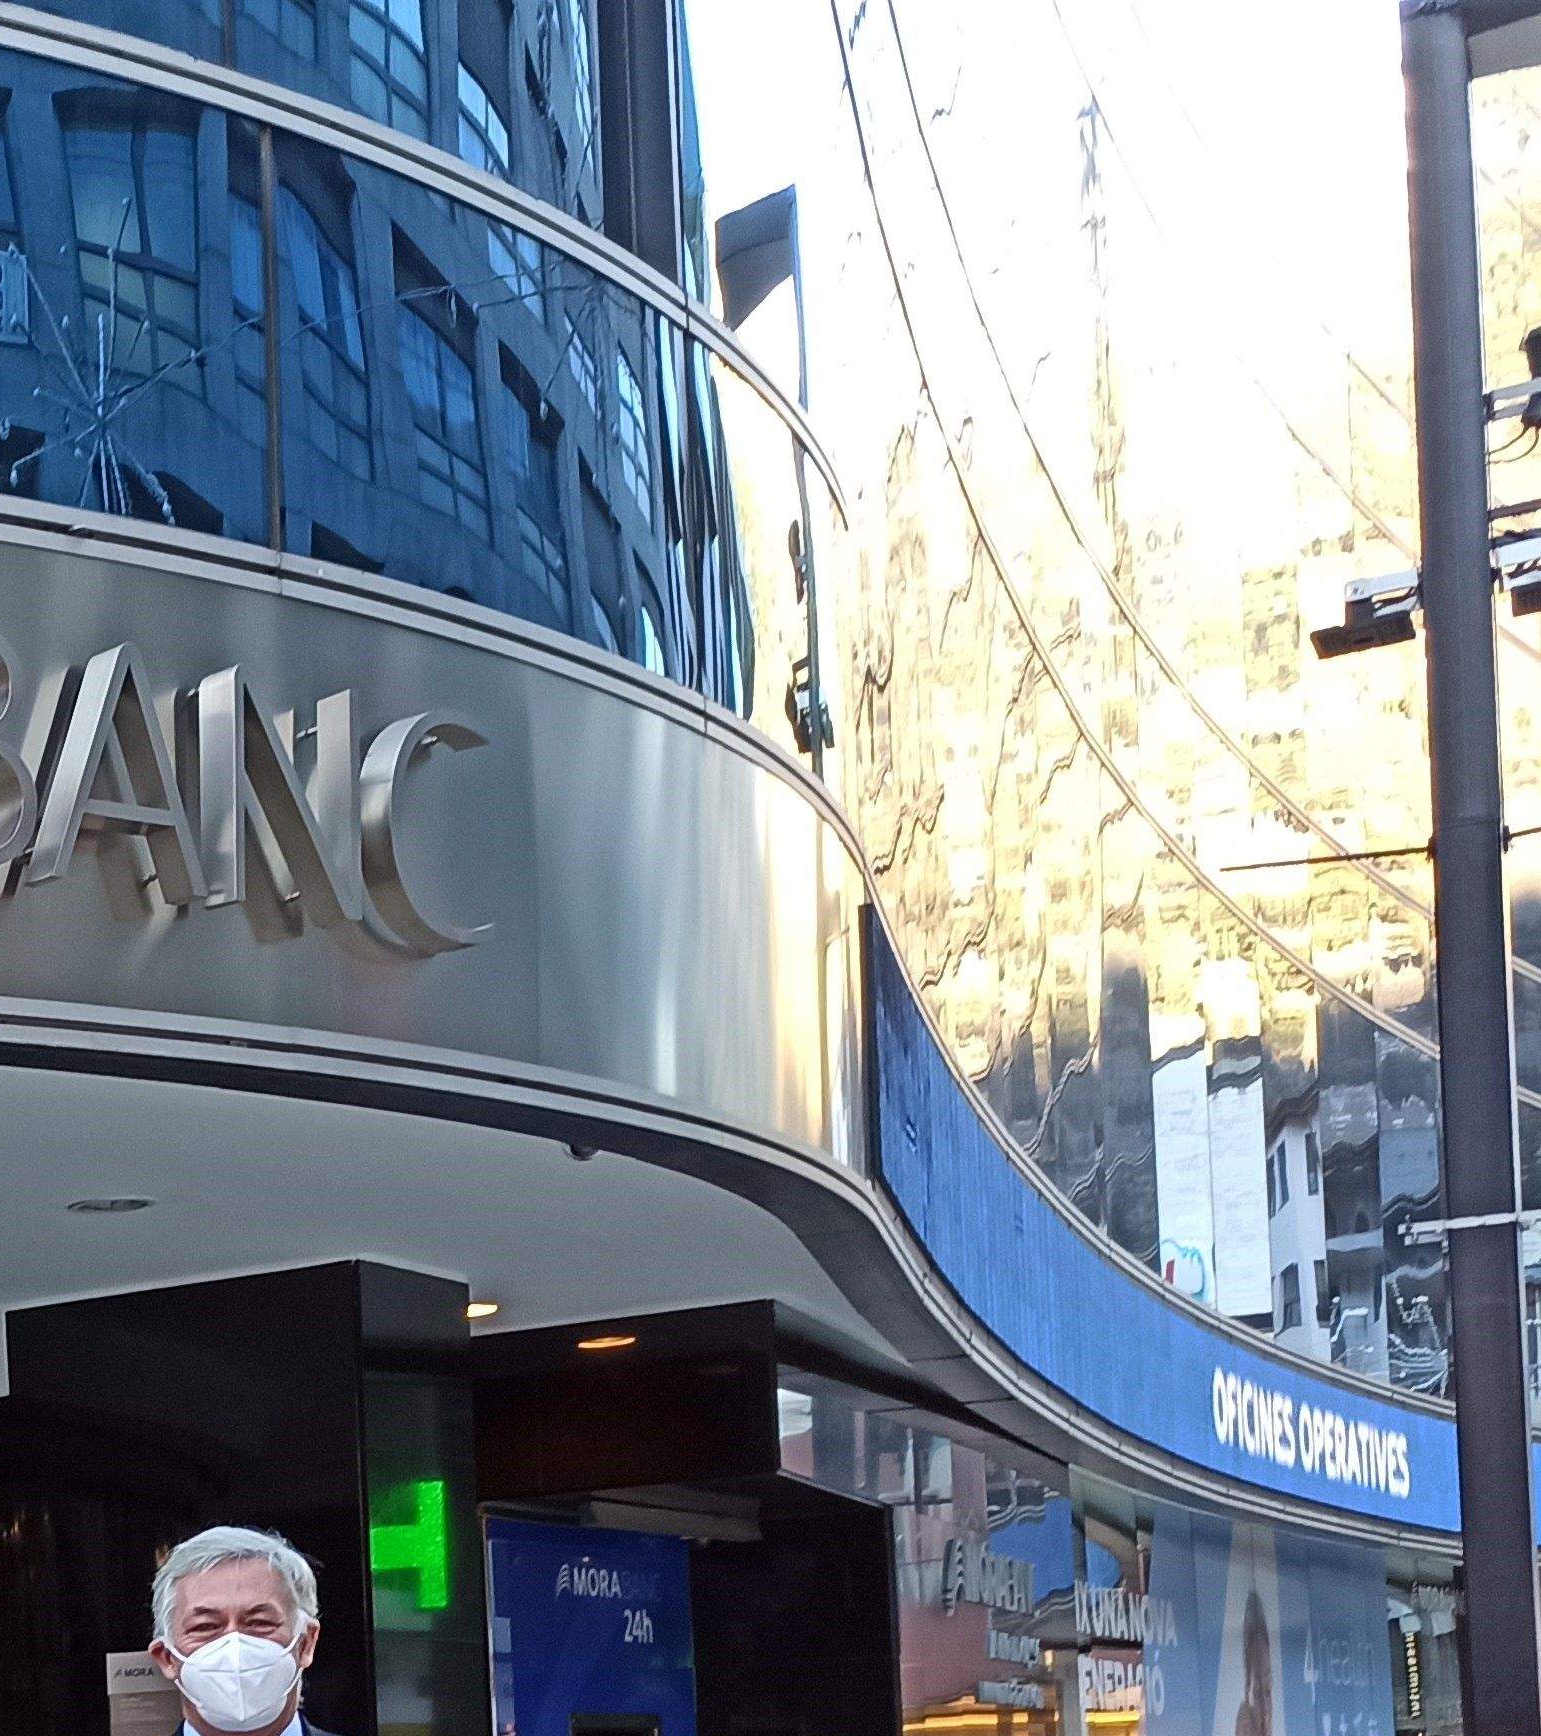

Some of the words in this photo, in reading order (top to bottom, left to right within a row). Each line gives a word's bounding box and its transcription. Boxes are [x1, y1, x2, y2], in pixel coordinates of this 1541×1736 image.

[1213, 1365, 1296, 1470] OFICINES
[1299, 1401, 1410, 1500] OPERATIVES
[623, 1608, 655, 1644] 24h
